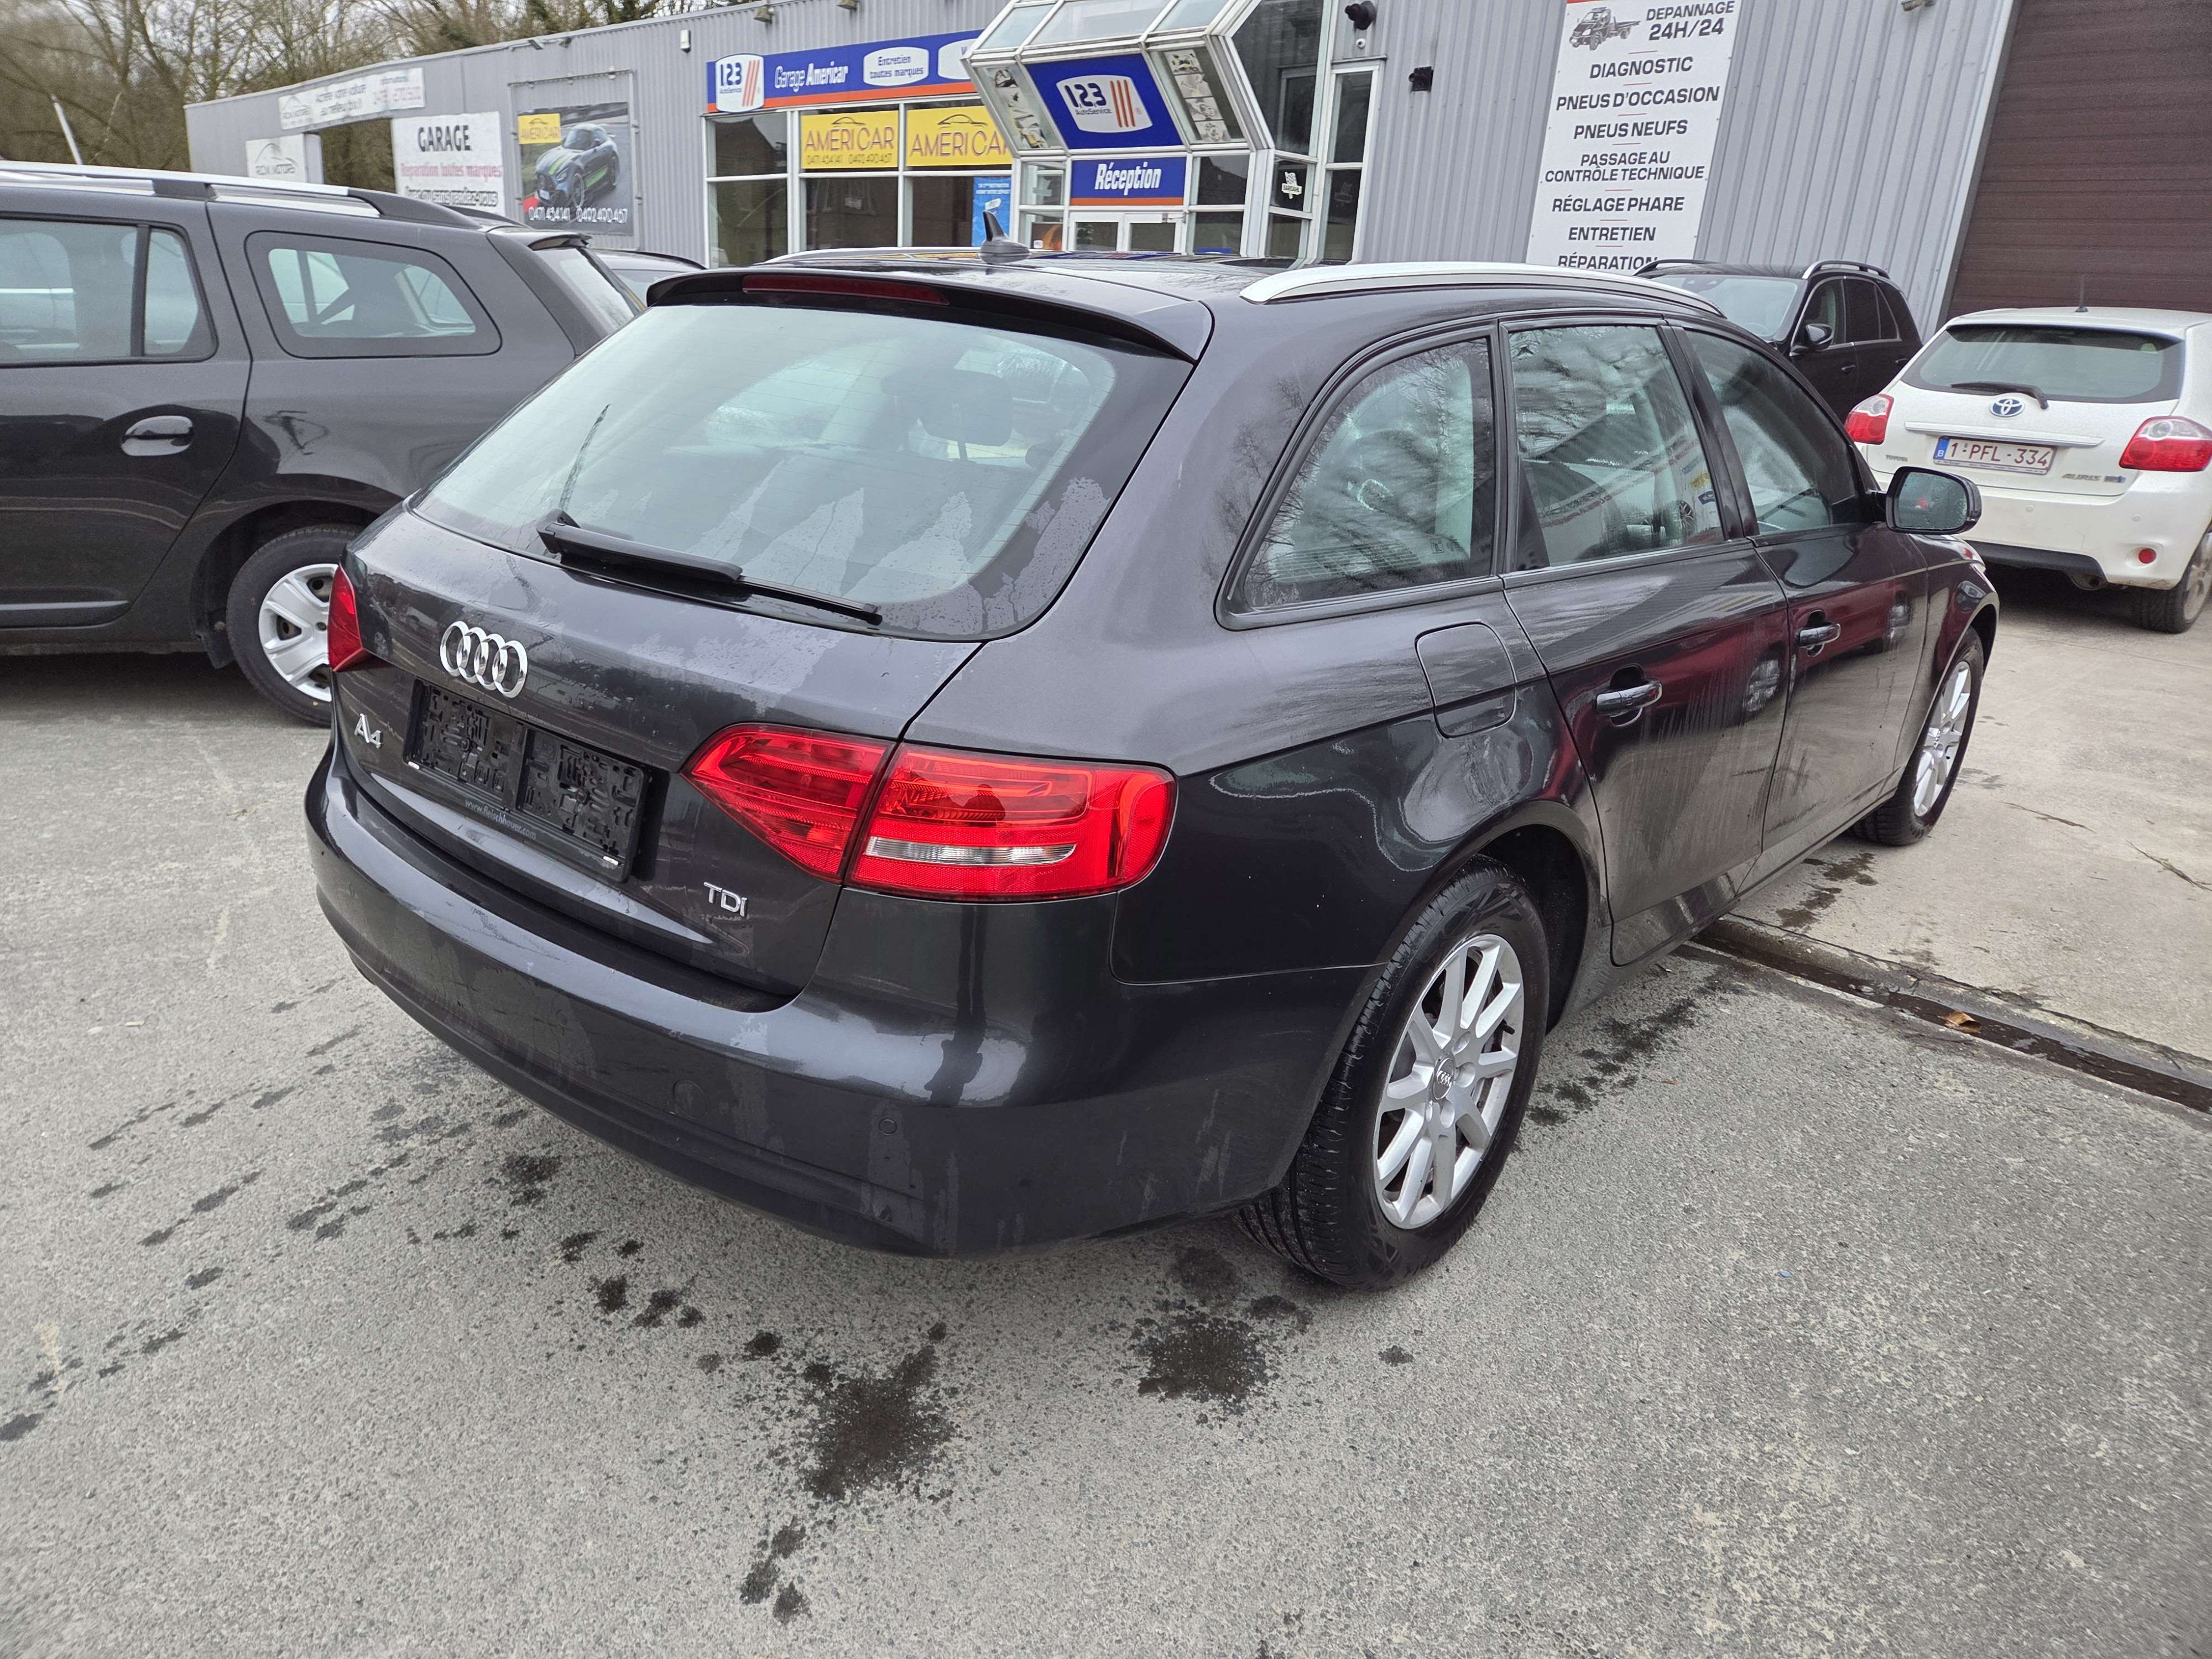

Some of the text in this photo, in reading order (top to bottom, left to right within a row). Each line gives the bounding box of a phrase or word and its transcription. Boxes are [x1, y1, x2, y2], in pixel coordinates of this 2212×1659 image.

[1646, 1, 1735, 21] DEPANNAGE
[1648, 18, 1725, 41] 24H/24
[878, 55, 911, 66] Entretien
[1589, 56, 1693, 79] DIAGNOSTIC
[774, 61, 849, 92] Garage Americar
[870, 67, 924, 79] toutes marques
[1556, 86, 1720, 111] PNEUS D'OCCASION
[1075, 107, 1113, 116] AutoService
[418, 124, 472, 152] GARAGE
[1574, 119, 1688, 140] PNEUS NEUFS
[1580, 150, 1671, 166] PASSAGE AU
[440, 162, 464, 178] toutes
[466, 165, 503, 182] marques
[1094, 161, 1162, 196] Réception
[1545, 165, 1705, 182] CONTRÔLE TECHNIQUE
[432, 190, 450, 205] sans
[450, 186, 498, 207] rendez-vous
[1552, 194, 1685, 212] RÉGLAGE PHARE
[1568, 227, 1656, 241] ENTRETIEN
[2061, 473, 2102, 482] AURIS
[353, 713, 382, 749] A4
[464, 799, 537, 840] www.fleischhauer.com
[703, 881, 748, 917] TDI
